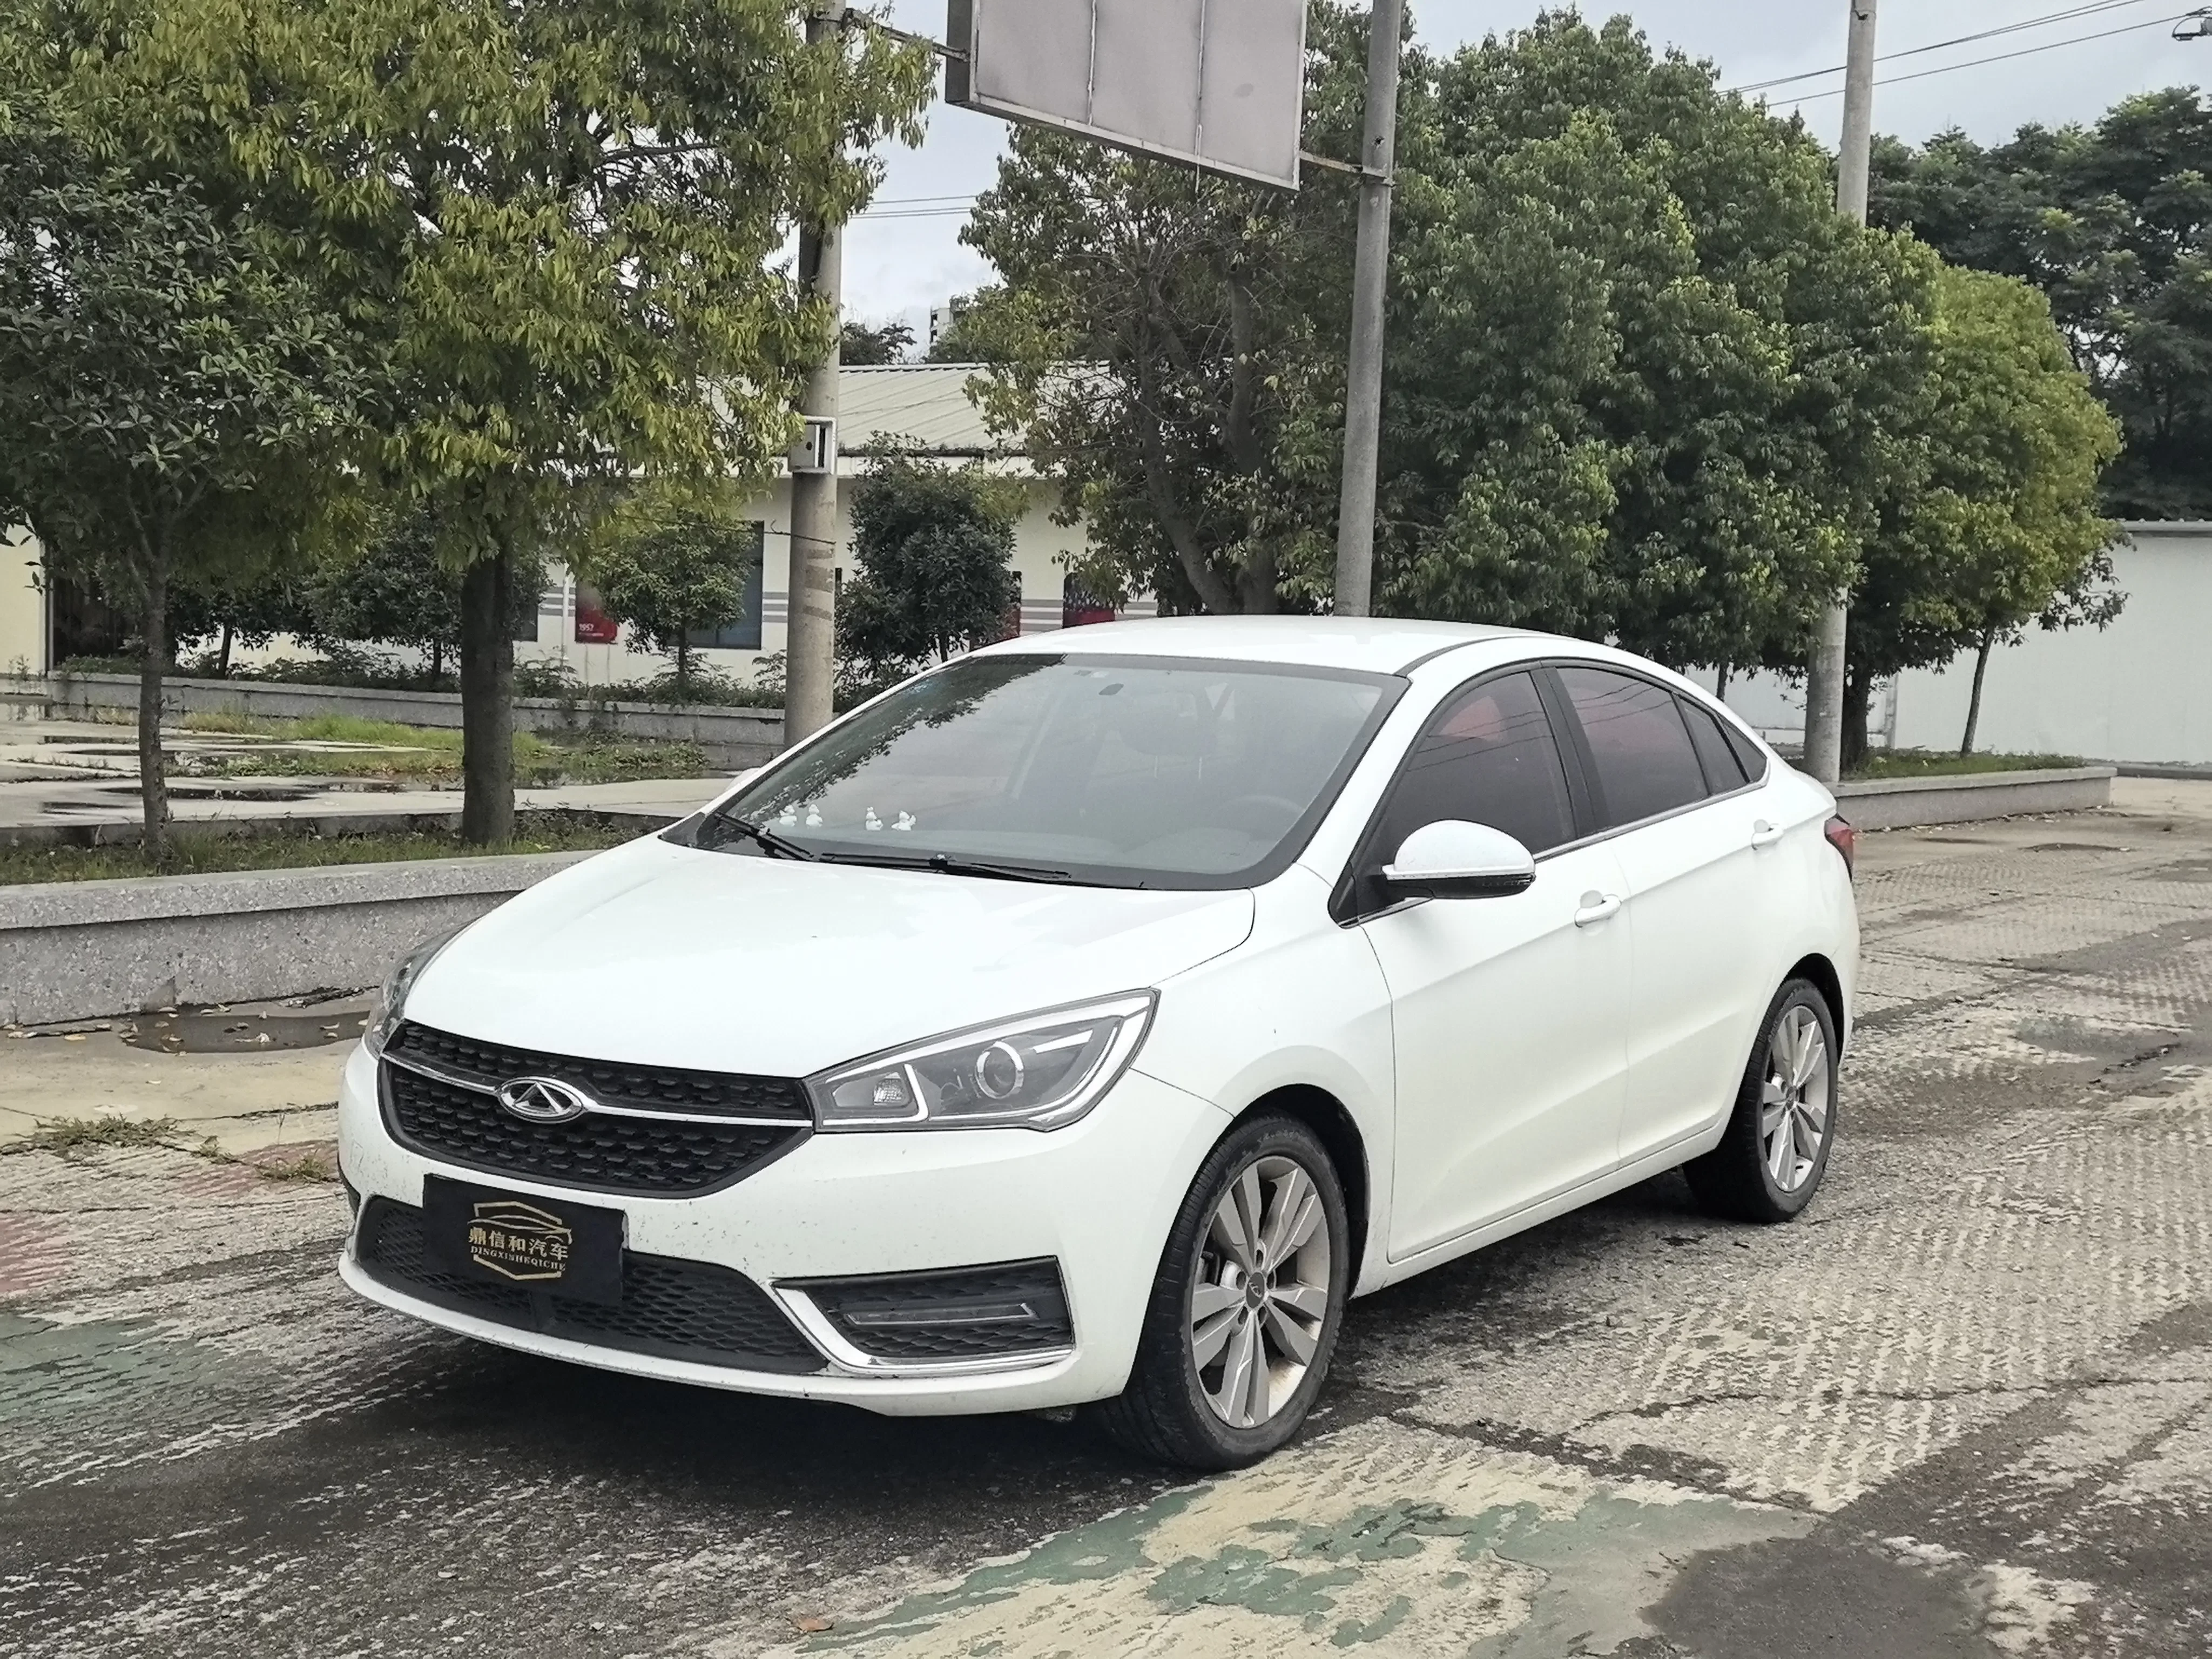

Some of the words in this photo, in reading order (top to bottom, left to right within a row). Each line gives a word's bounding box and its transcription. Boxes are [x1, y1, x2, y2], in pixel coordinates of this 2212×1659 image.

[469, 1226, 569, 1260] 鼎信和汽车
